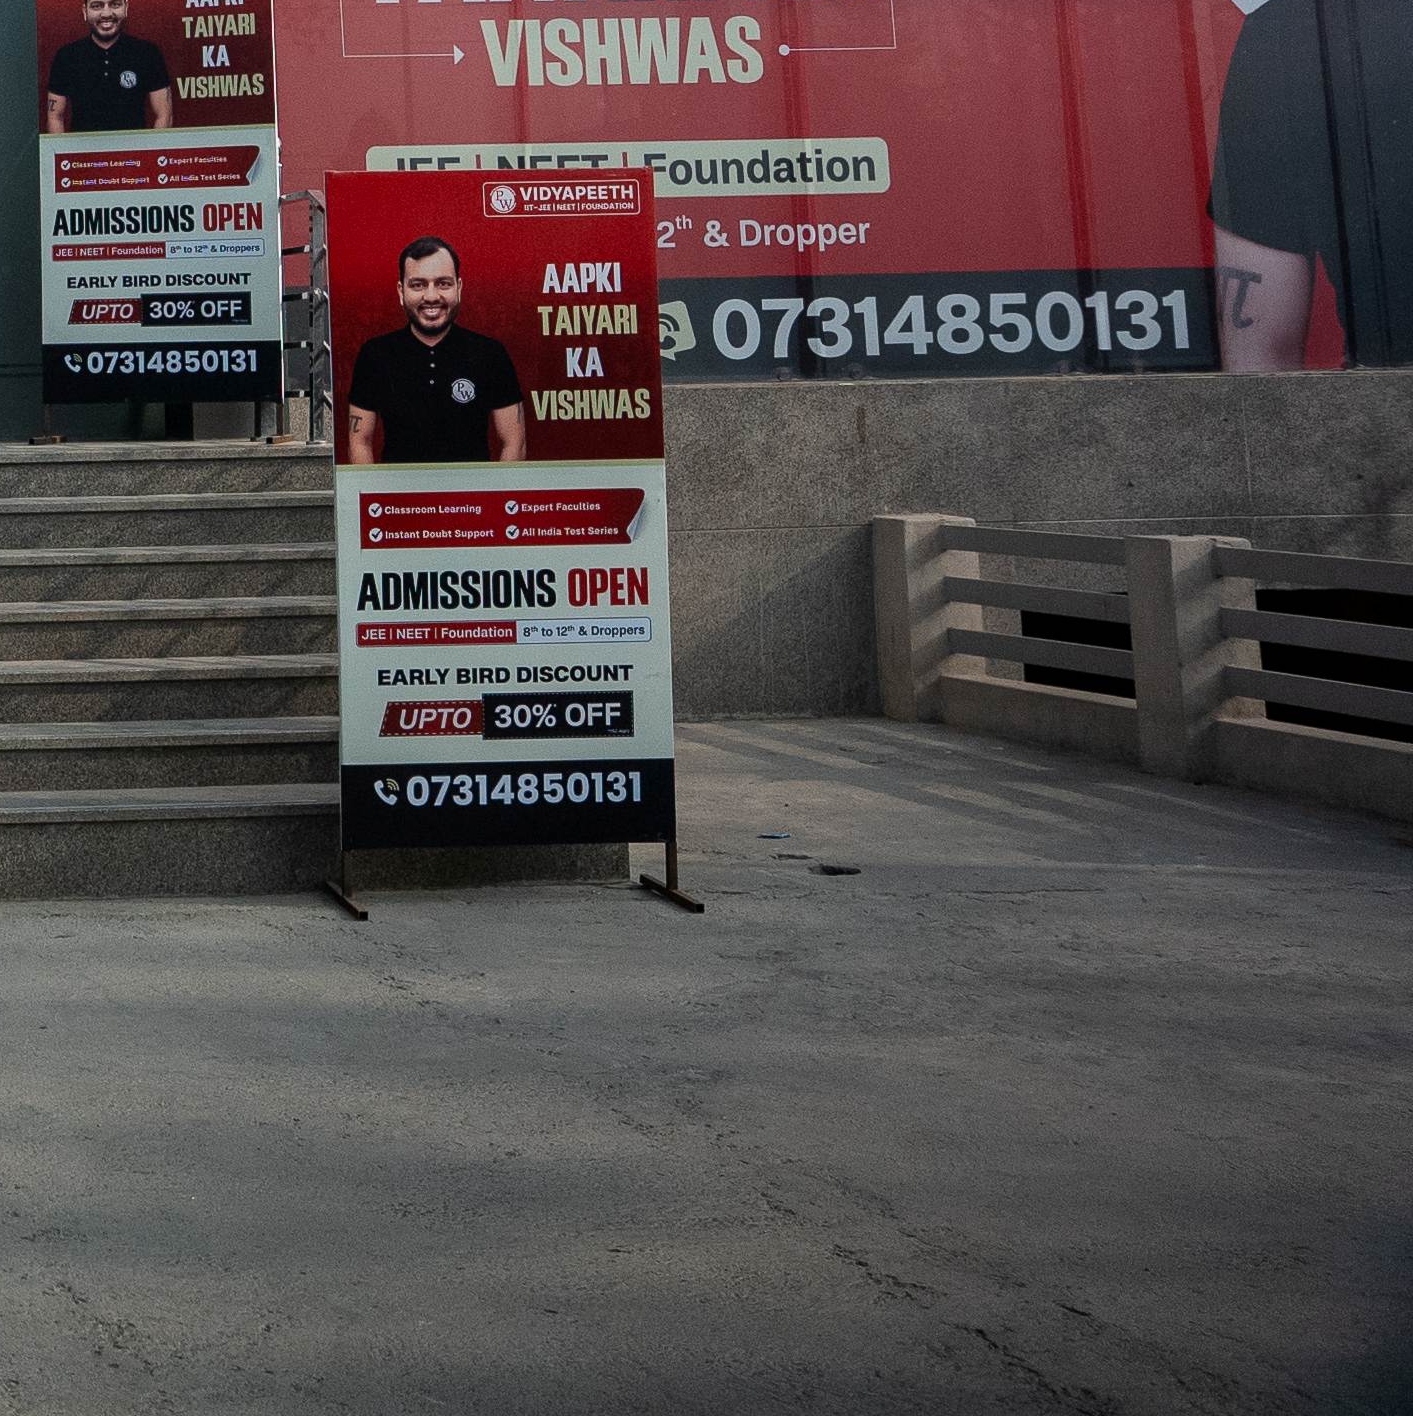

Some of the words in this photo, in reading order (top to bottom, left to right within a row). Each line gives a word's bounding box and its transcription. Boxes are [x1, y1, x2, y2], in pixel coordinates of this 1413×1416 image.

[182, 13, 256, 38] TAIYARI
[202, 45, 230, 68] KA
[479, 15, 765, 87] VISHWAS
[176, 73, 265, 99] VISHWAS
[520, 184, 634, 201] VIDYAPEETH
[581, 202, 634, 210] FOUNDATION
[53, 204, 195, 237] ADMISSIONS
[203, 202, 263, 232] OPEN
[656, 215, 693, 249] 2th
[703, 220, 730, 248] &
[739, 218, 871, 252] Dropper
[55, 248, 73, 257] JEE
[79, 247, 105, 256] NEET
[111, 246, 163, 256] Foundation
[219, 244, 260, 255] Droppers
[67, 276, 118, 289] EARLY
[122, 275, 162, 288] BIRD
[165, 272, 252, 287] DISCOUNT
[542, 262, 621, 293] AAPKI
[82, 303, 134, 320] UPTO
[200, 300, 242, 318] OFF
[537, 304, 638, 336] TAIYARI
[711, 289, 1191, 361] 07314850131
[87, 349, 257, 374] 07314850131
[566, 347, 604, 378] KA
[531, 389, 651, 421] VISHWAS
[384, 505, 436, 515] Classroom
[439, 504, 482, 516] Learning
[521, 503, 554, 514] Expert
[556, 502, 601, 512] Faculties
[385, 529, 420, 539] Instant
[422, 529, 452, 538] Doubt
[454, 529, 494, 540] Support
[521, 527, 535, 536] All
[537, 527, 562, 536] India
[564, 526, 585, 536] Test
[587, 526, 619, 535] Series
[357, 569, 557, 611] ADMISSIONS
[567, 567, 649, 607] OPEN
[361, 628, 386, 640] JEE
[396, 627, 431, 640] NEET
[441, 626, 514, 639] Foundation
[541, 626, 554, 637] to
[578, 626, 588, 637] &
[591, 624, 646, 639] Droppers
[377, 668, 450, 686] EARLY
[456, 667, 511, 685] BIRD
[516, 664, 634, 683] DISCOUNT
[399, 707, 472, 730] UPTO
[565, 702, 621, 727] OFF
[406, 771, 641, 807] 07314850131
